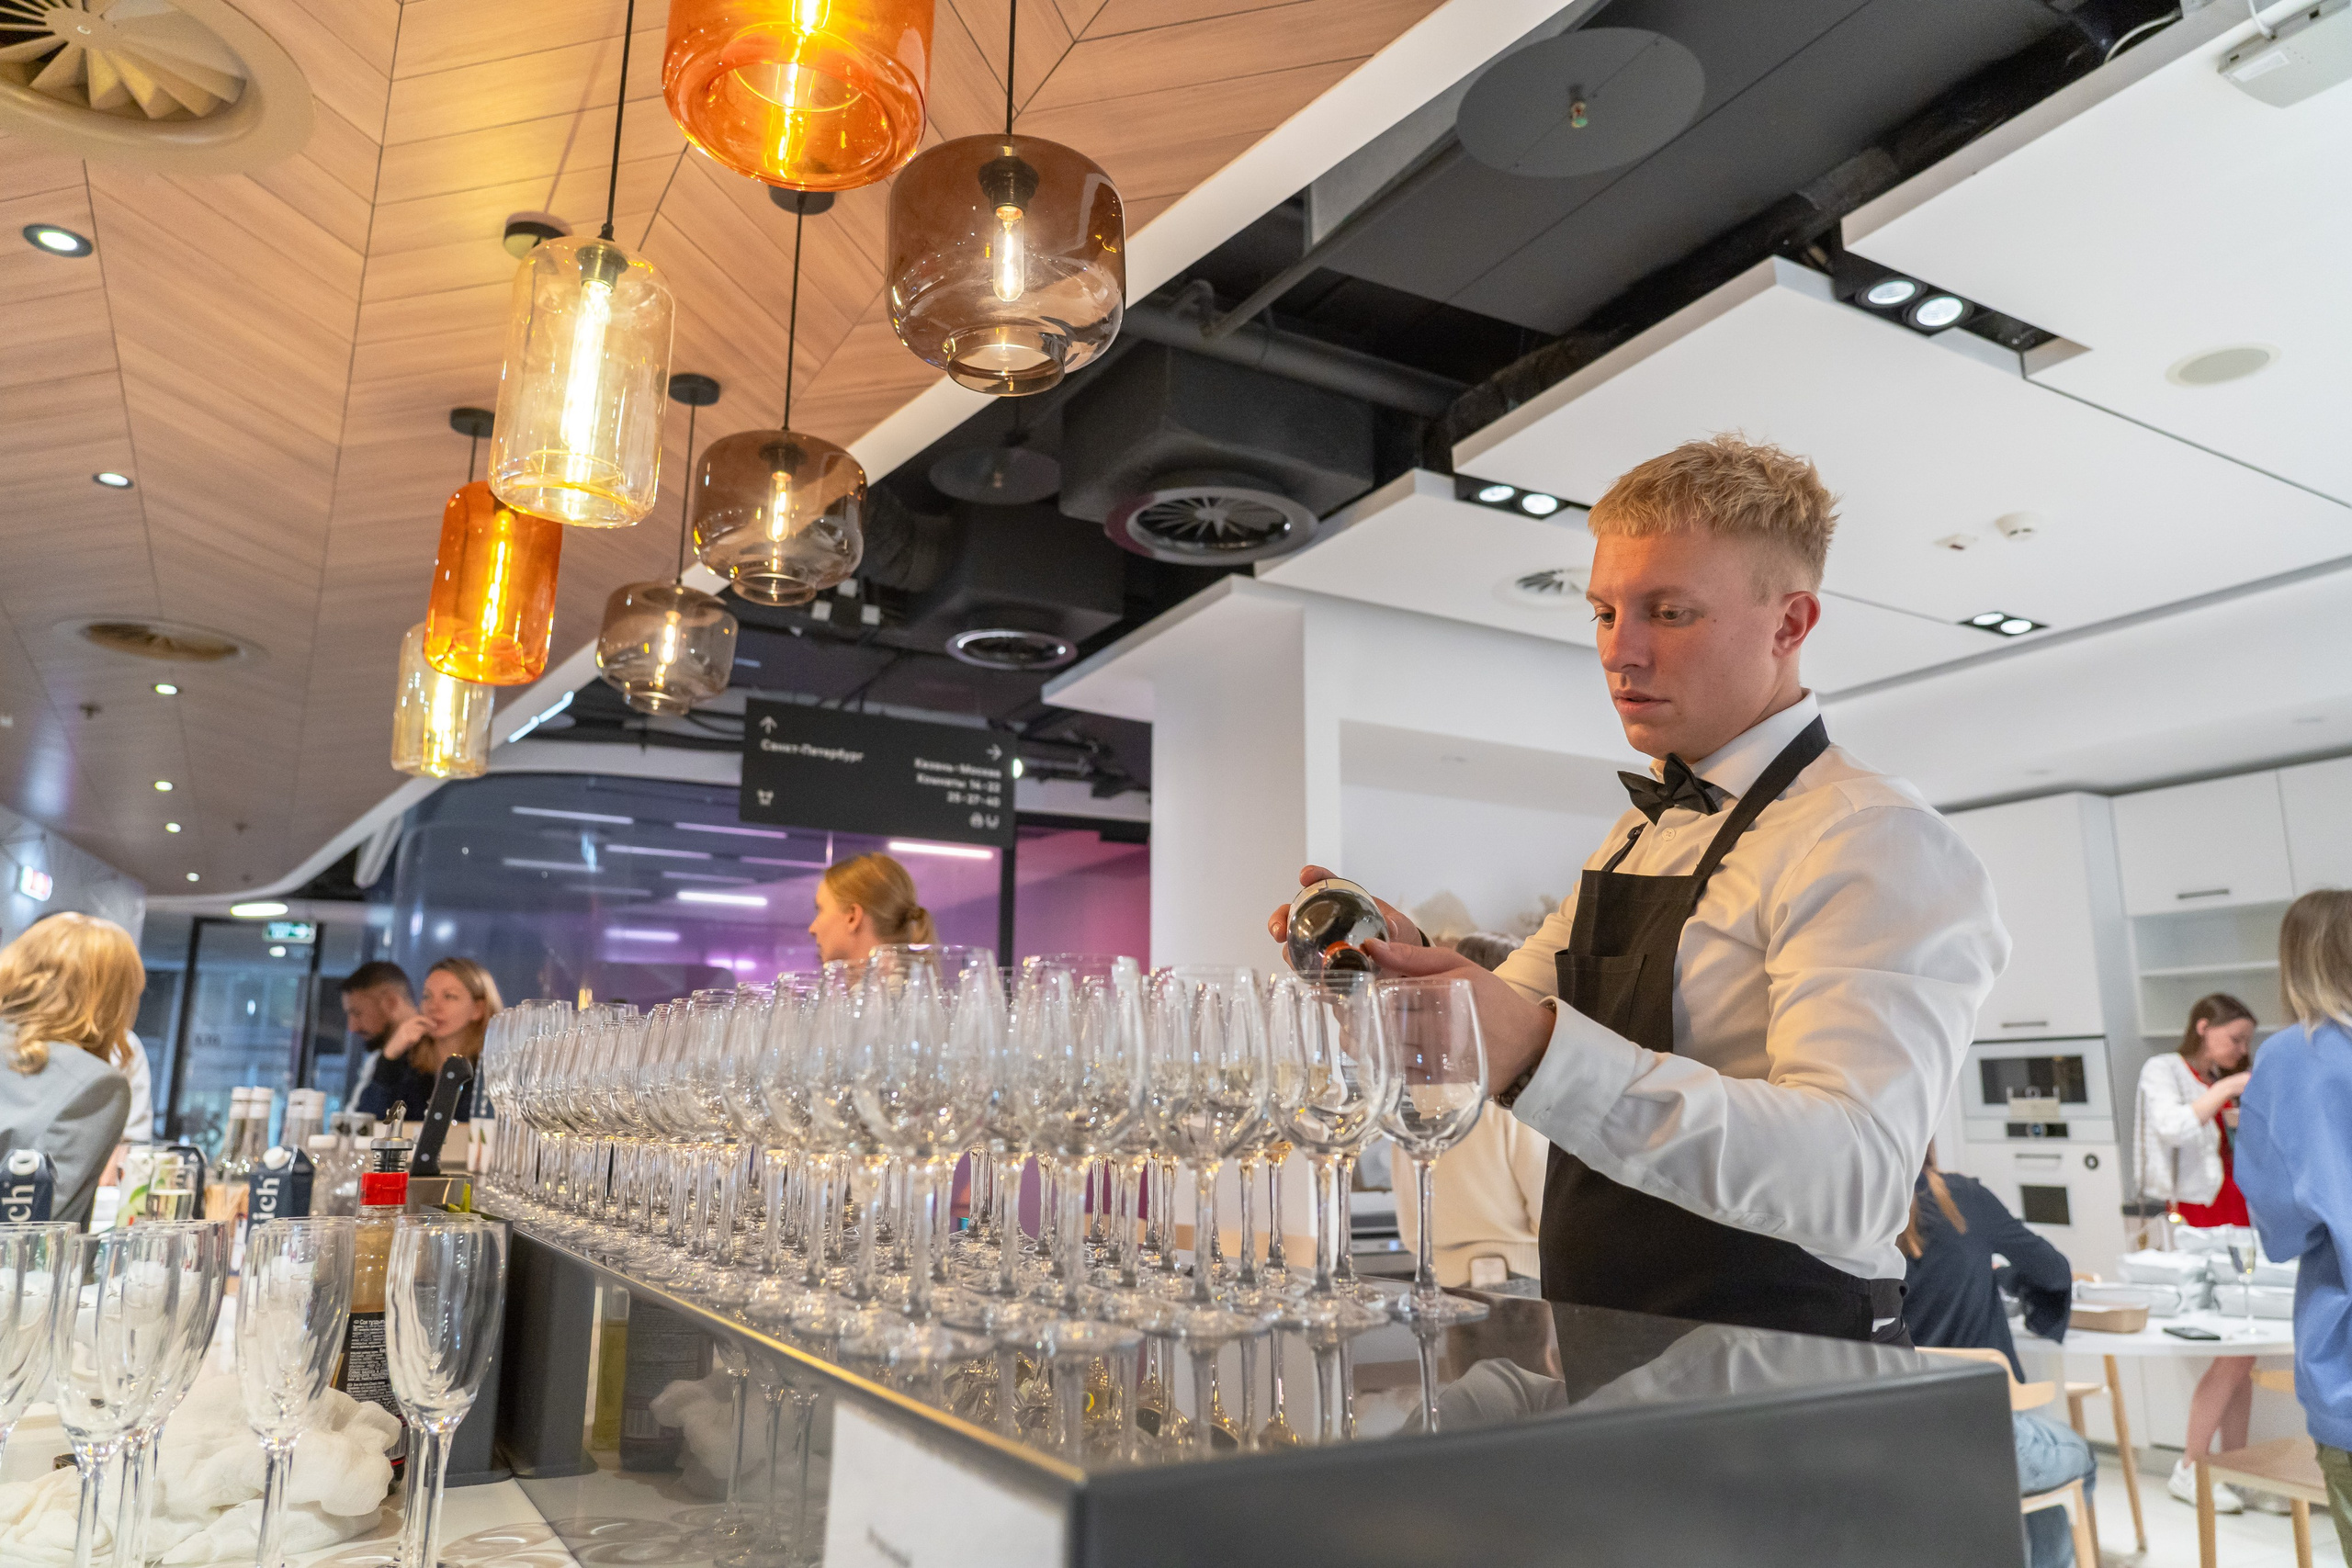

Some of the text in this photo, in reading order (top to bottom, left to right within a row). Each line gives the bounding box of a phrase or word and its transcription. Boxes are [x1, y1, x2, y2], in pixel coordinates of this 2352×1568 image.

[761, 739, 865, 763] Санкт-Петербург
[1, 1184, 36, 1222] ch
[252, 1178, 280, 1230] ich
